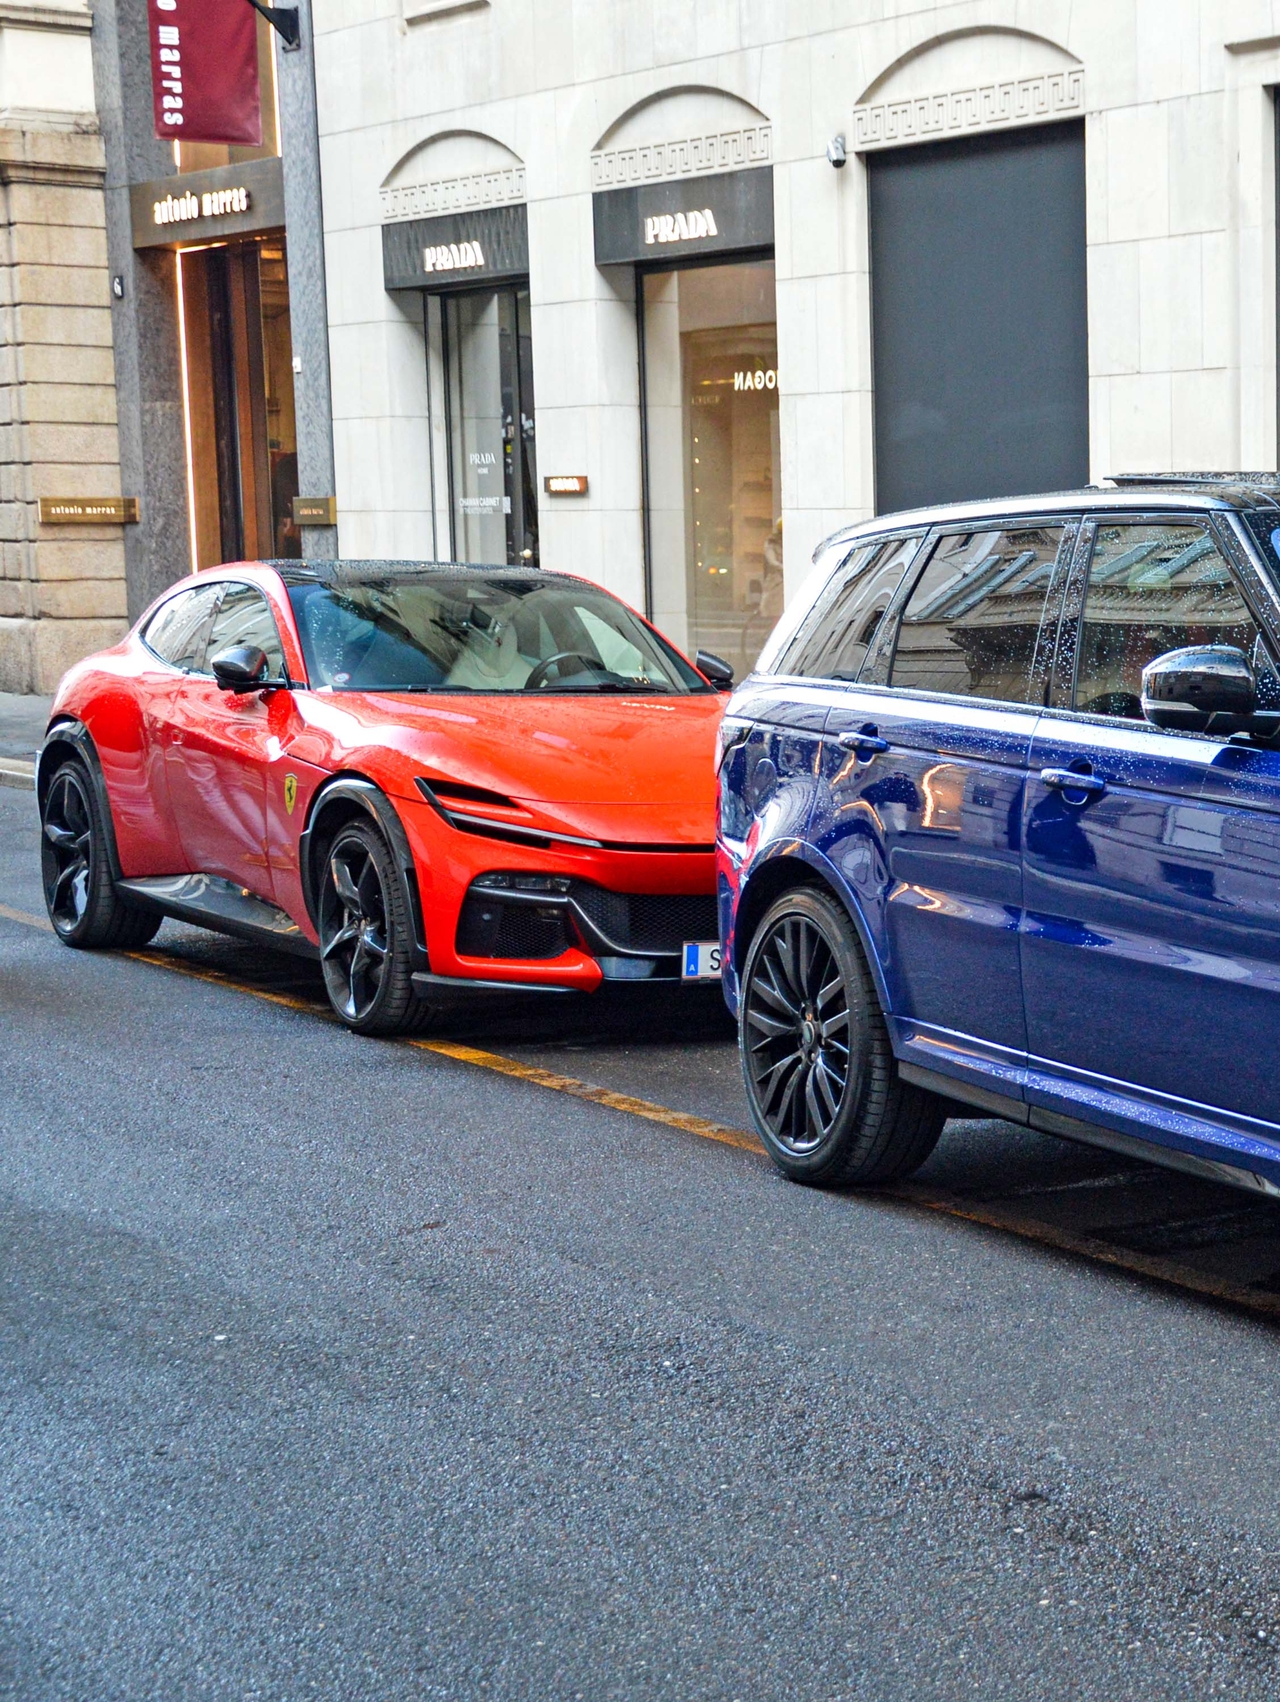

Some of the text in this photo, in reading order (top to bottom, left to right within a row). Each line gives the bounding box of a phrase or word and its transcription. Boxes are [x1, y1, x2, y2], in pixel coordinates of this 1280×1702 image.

[158, 25, 184, 125] marras
[154, 187, 248, 225] antonio marras
[644, 208, 718, 244] PRADA
[423, 240, 485, 272] PRADA
[469, 452, 496, 465] PRADA
[51, 505, 116, 514] antonio marras
